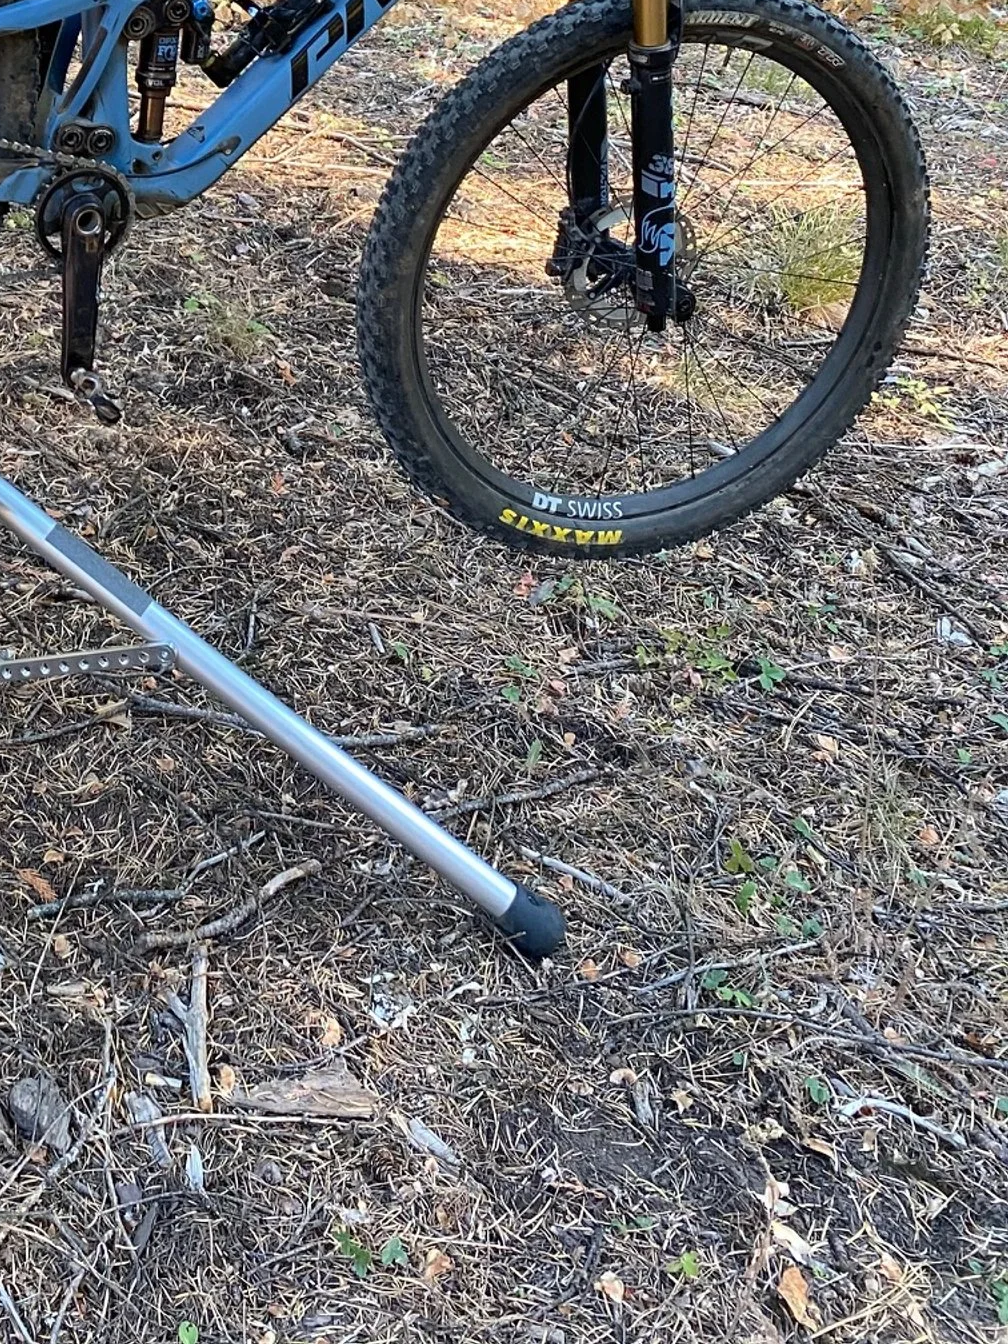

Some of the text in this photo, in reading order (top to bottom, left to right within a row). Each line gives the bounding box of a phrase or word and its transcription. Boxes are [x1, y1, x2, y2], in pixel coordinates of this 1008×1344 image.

[532, 492, 623, 520] DT SWISS
[498, 508, 623, 546] MAXXIS
